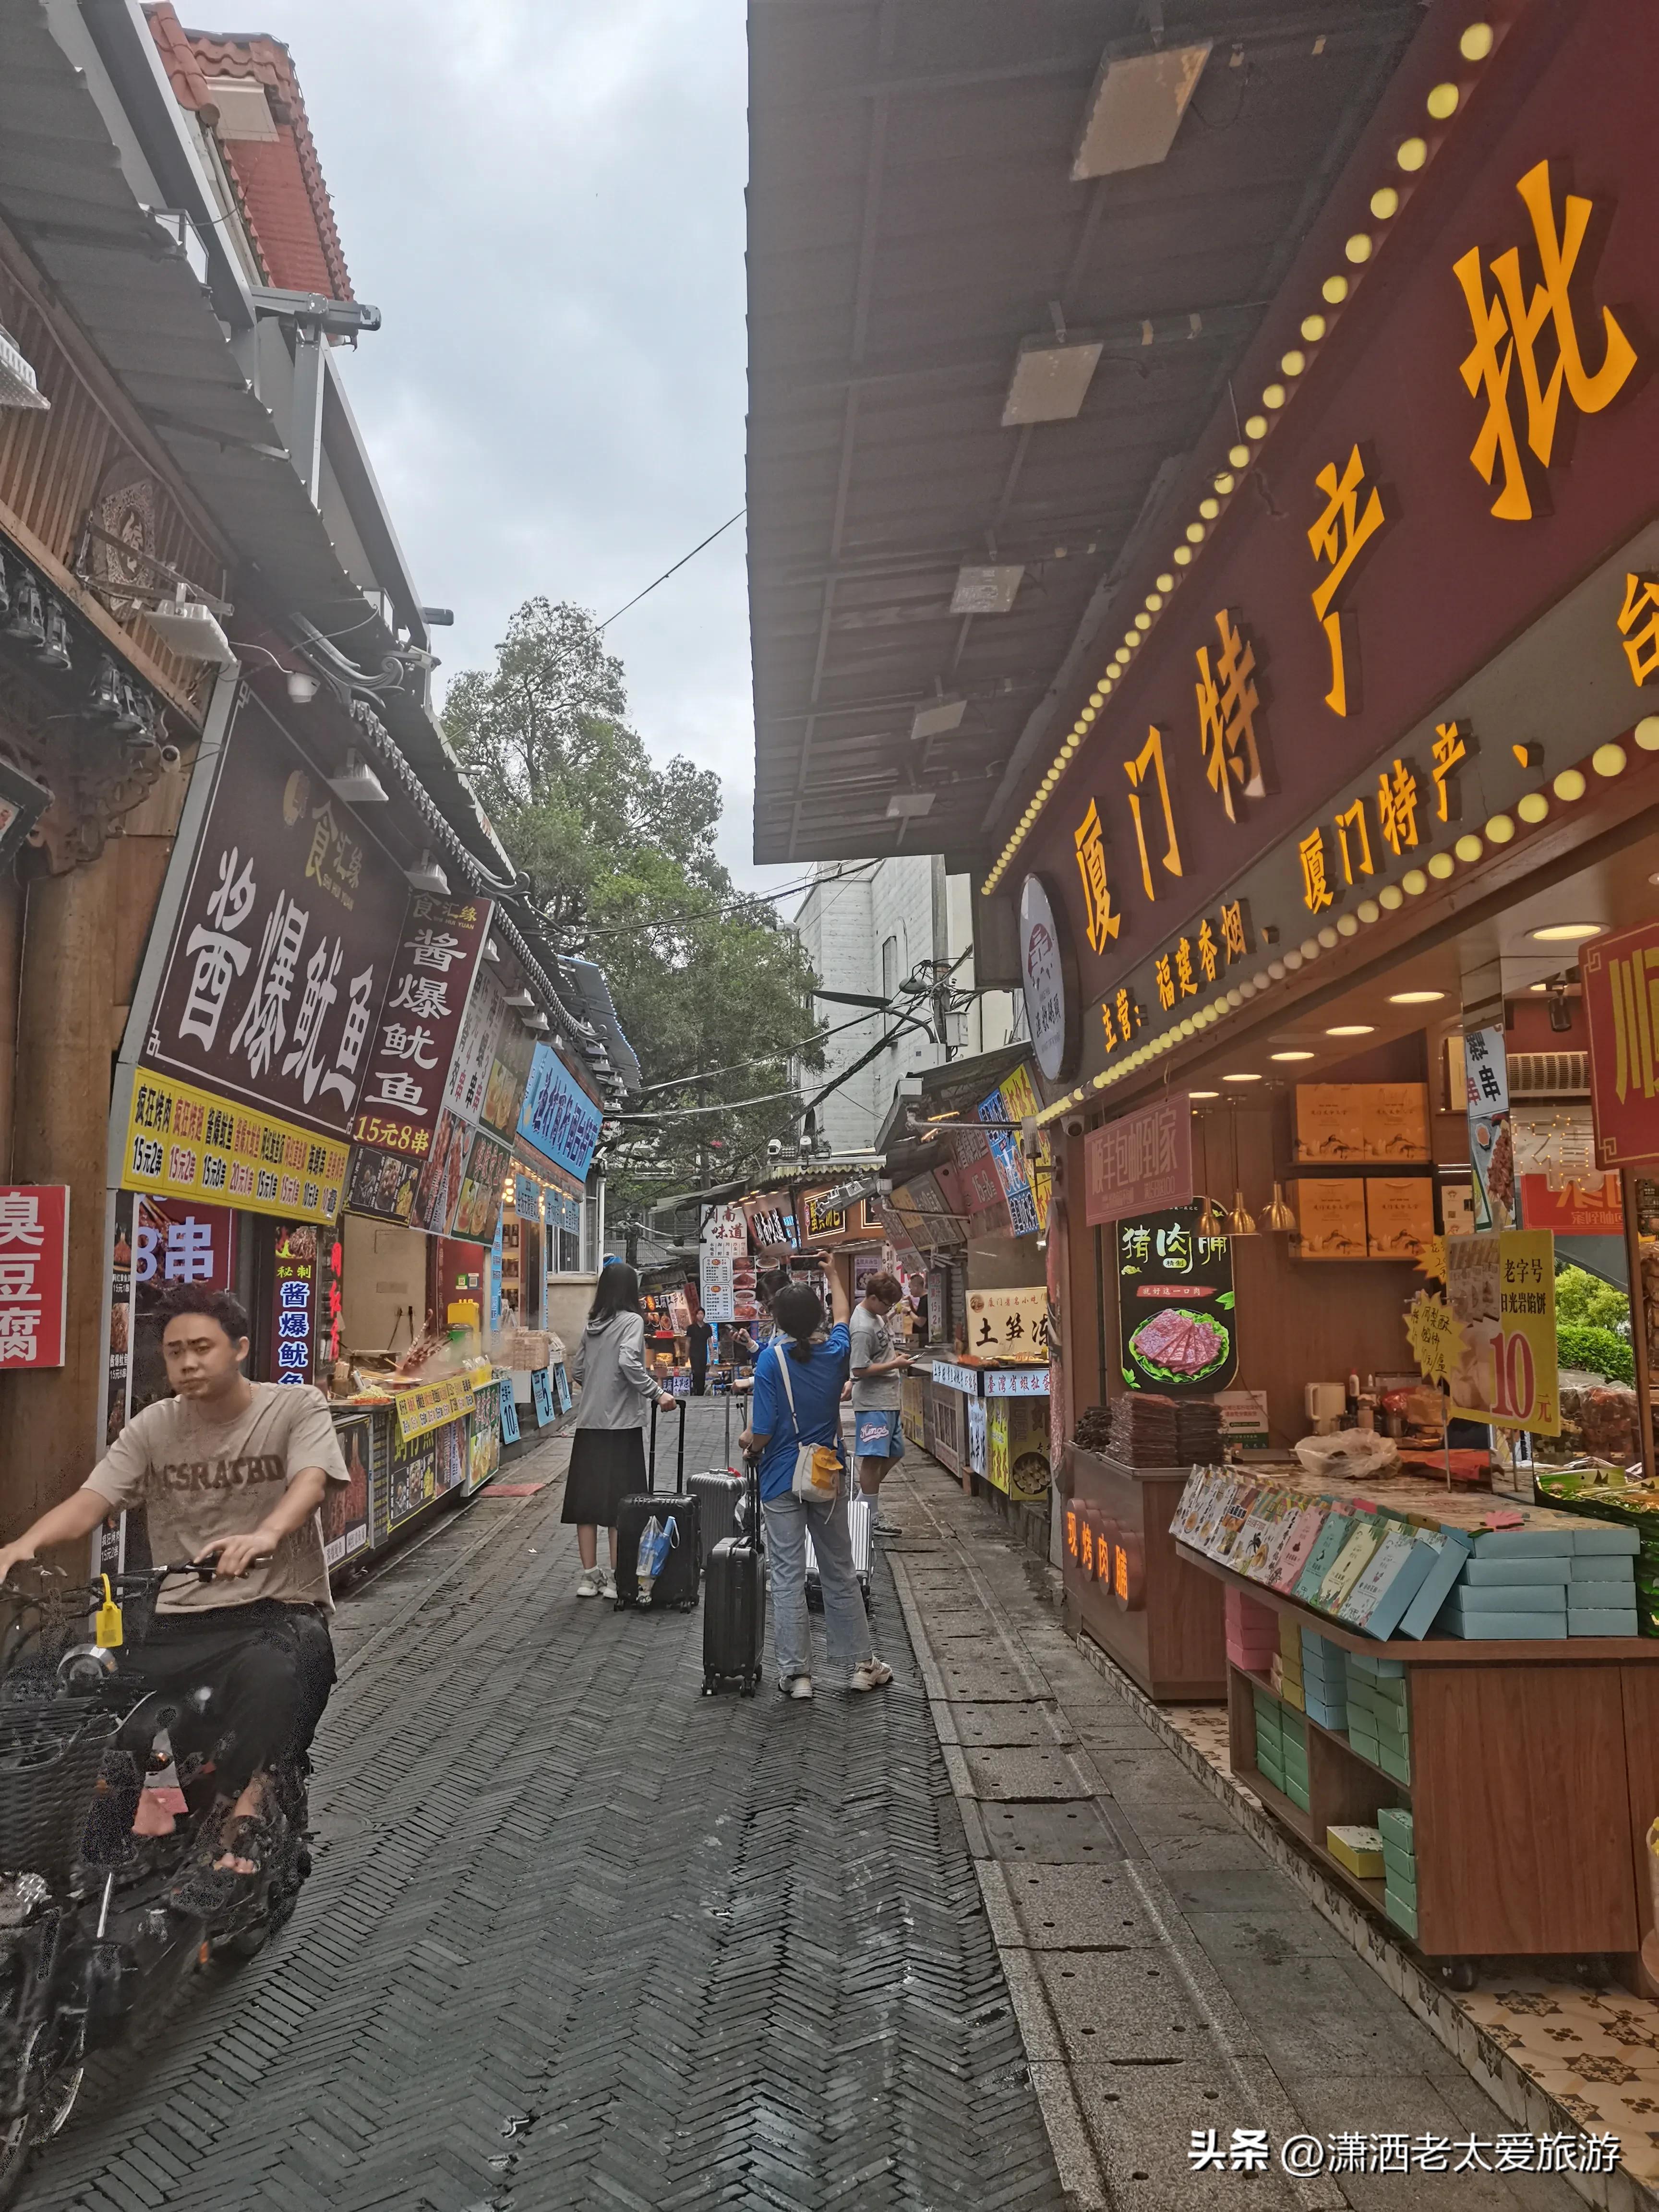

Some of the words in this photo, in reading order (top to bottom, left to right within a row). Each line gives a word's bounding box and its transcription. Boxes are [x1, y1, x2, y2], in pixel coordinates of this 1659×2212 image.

[1074, 160, 1637, 955] 厦门特产批
[179, 846, 374, 1112] 酱爆鱿鱼
[364, 929, 467, 1116] 酱爆鱿鱼
[356, 1116, 430, 1154] 15元8串
[1092, 1108, 1178, 1196] 顺丰包邮到家
[0, 1191, 44, 1362] 臭豆腐
[276, 1265, 312, 1279] 秘制
[1501, 1292, 1546, 1315] 日光岩馅饼
[1503, 1258, 1544, 1284] 老字号
[1490, 1331, 1535, 1419] 10
[1537, 1394, 1552, 1423] 元
[860, 1422, 890, 1442] Kings
